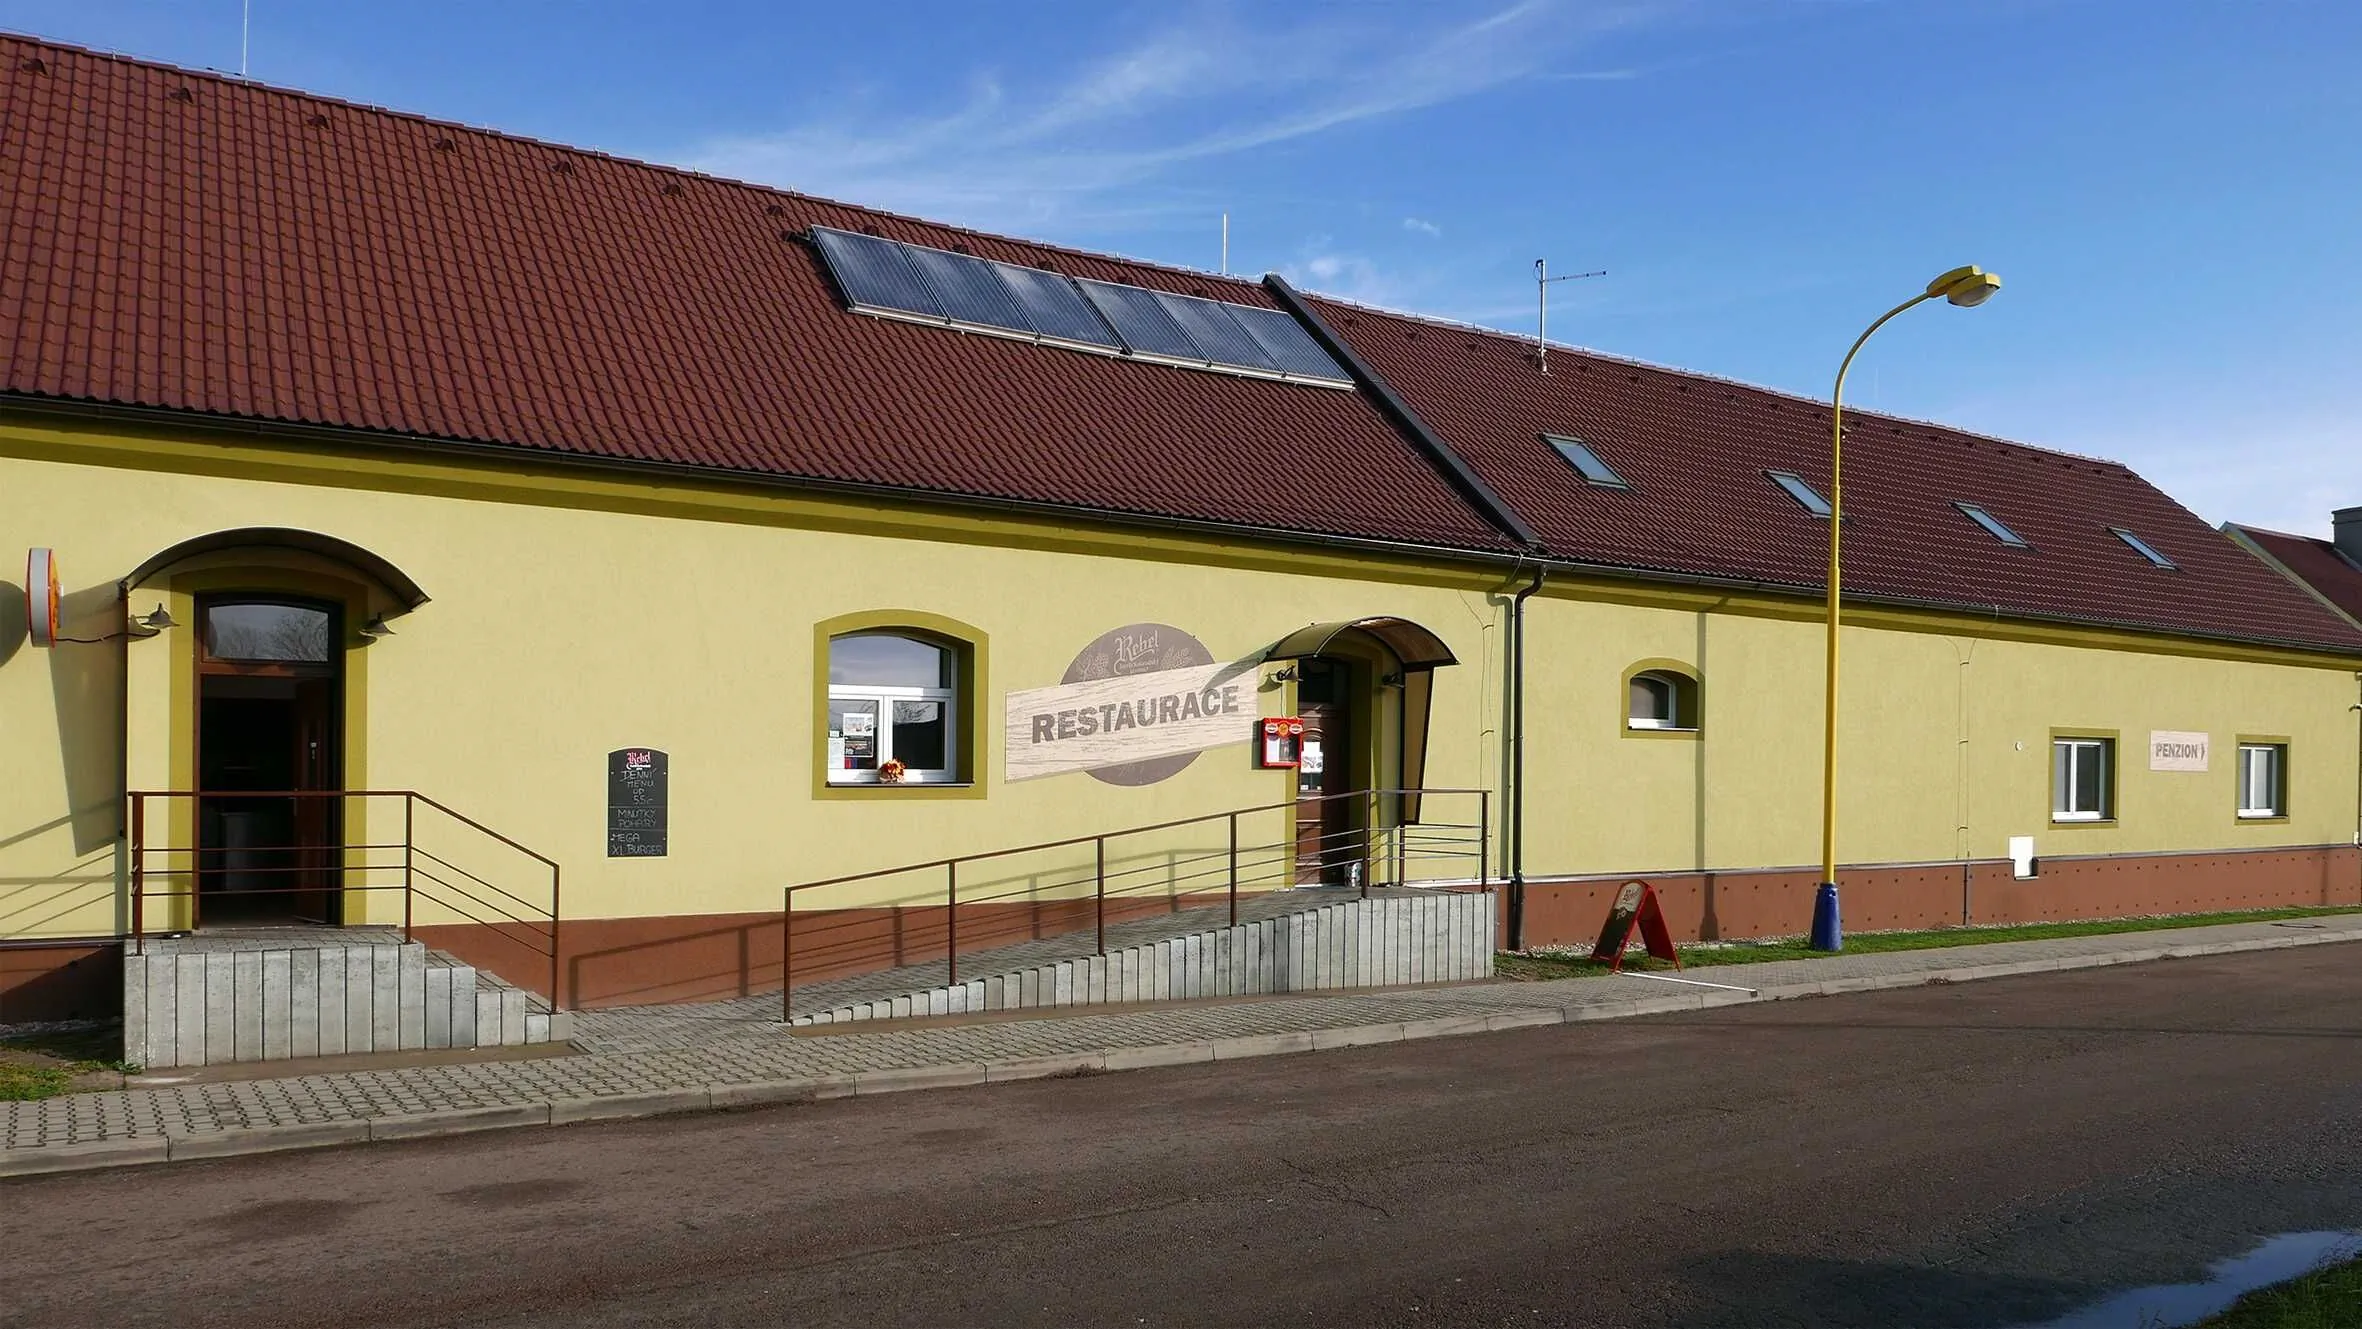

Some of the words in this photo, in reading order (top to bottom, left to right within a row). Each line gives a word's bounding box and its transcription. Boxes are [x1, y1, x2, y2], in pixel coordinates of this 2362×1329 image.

[1114, 630, 1160, 662] Rebel
[1031, 685, 1239, 744] RESTAURACE
[2155, 742, 2198, 759] PENZION
